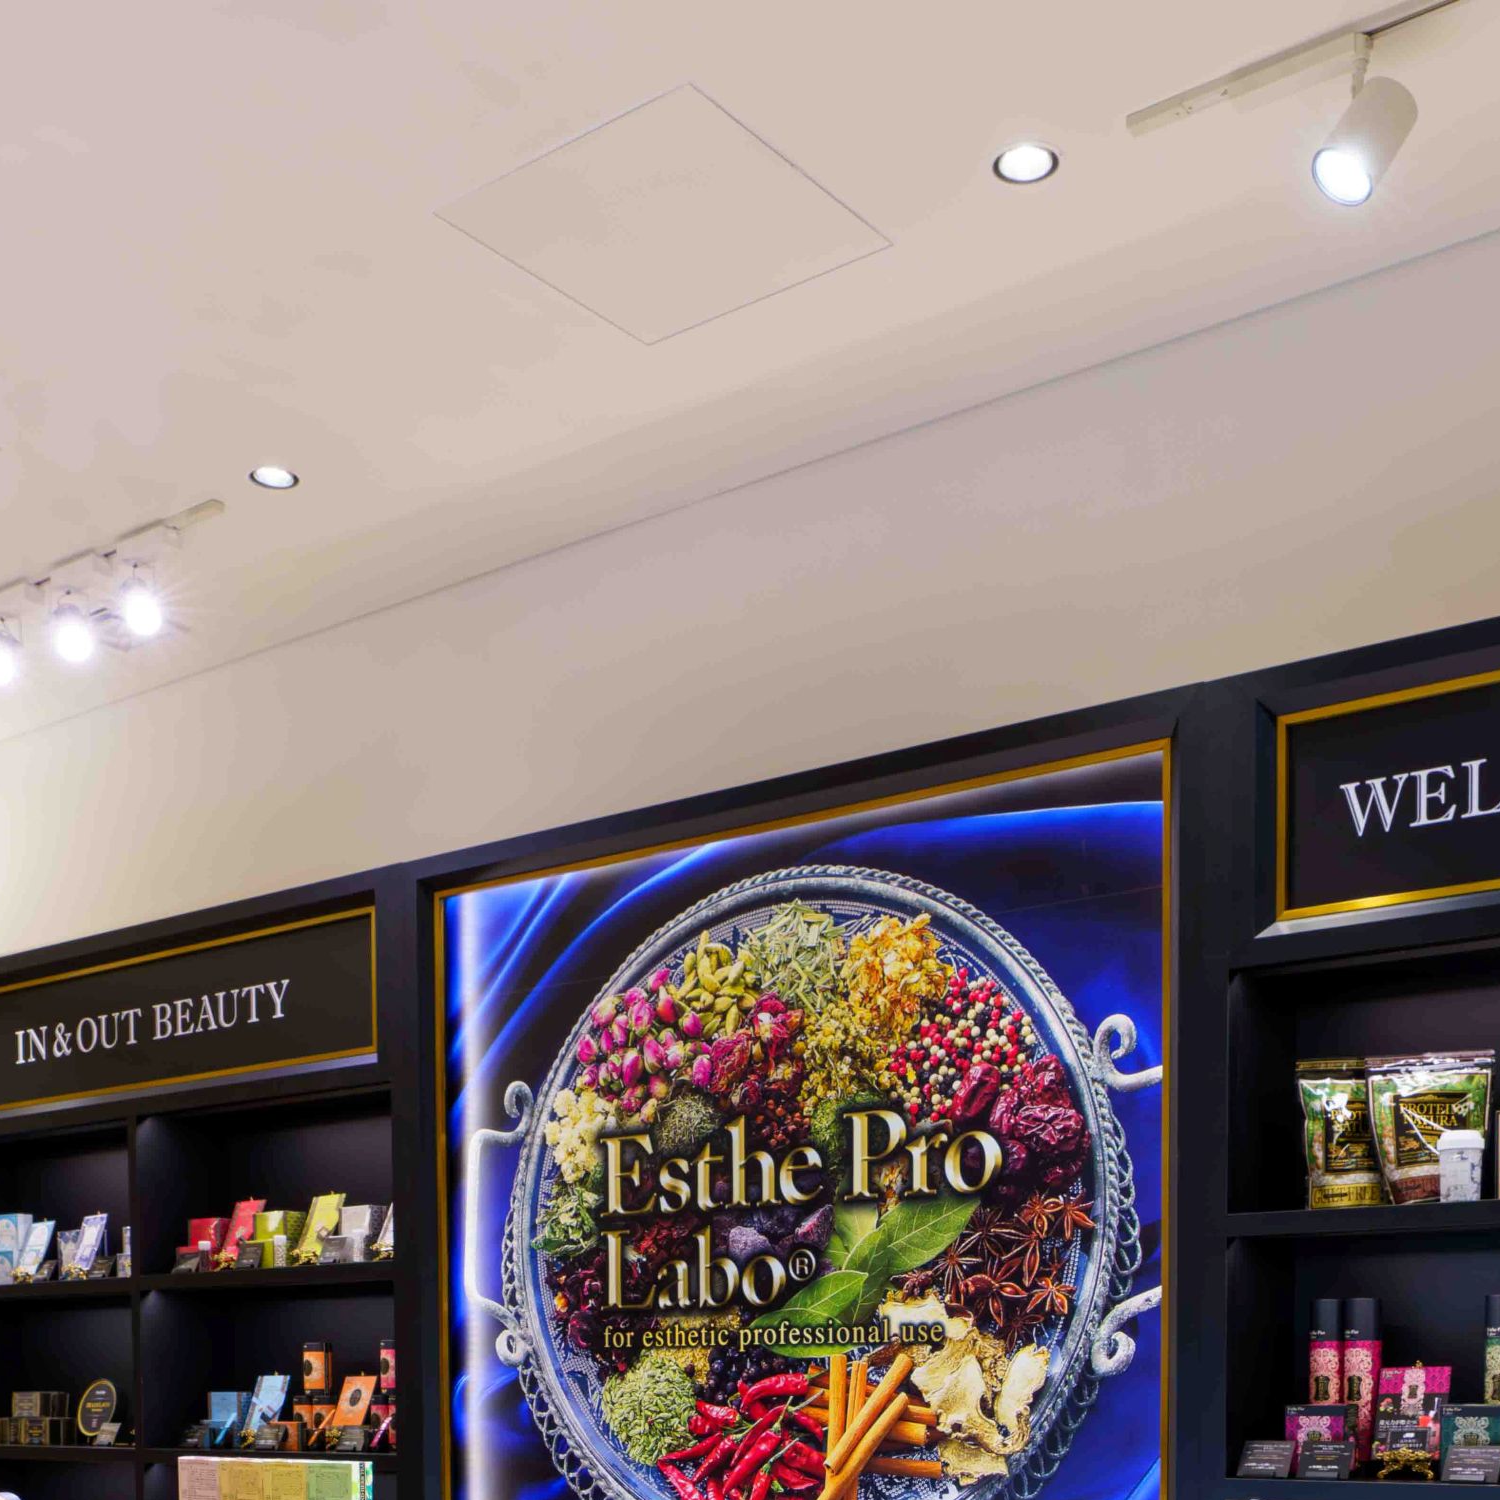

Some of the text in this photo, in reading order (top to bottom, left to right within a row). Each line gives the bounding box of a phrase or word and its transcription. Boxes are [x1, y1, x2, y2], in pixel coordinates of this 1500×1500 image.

[15, 979, 290, 1065] IN&OUT BEAUTY
[600, 1109, 1003, 1217] Esthe Pro
[604, 1320, 944, 1352] for esthetic professional use
